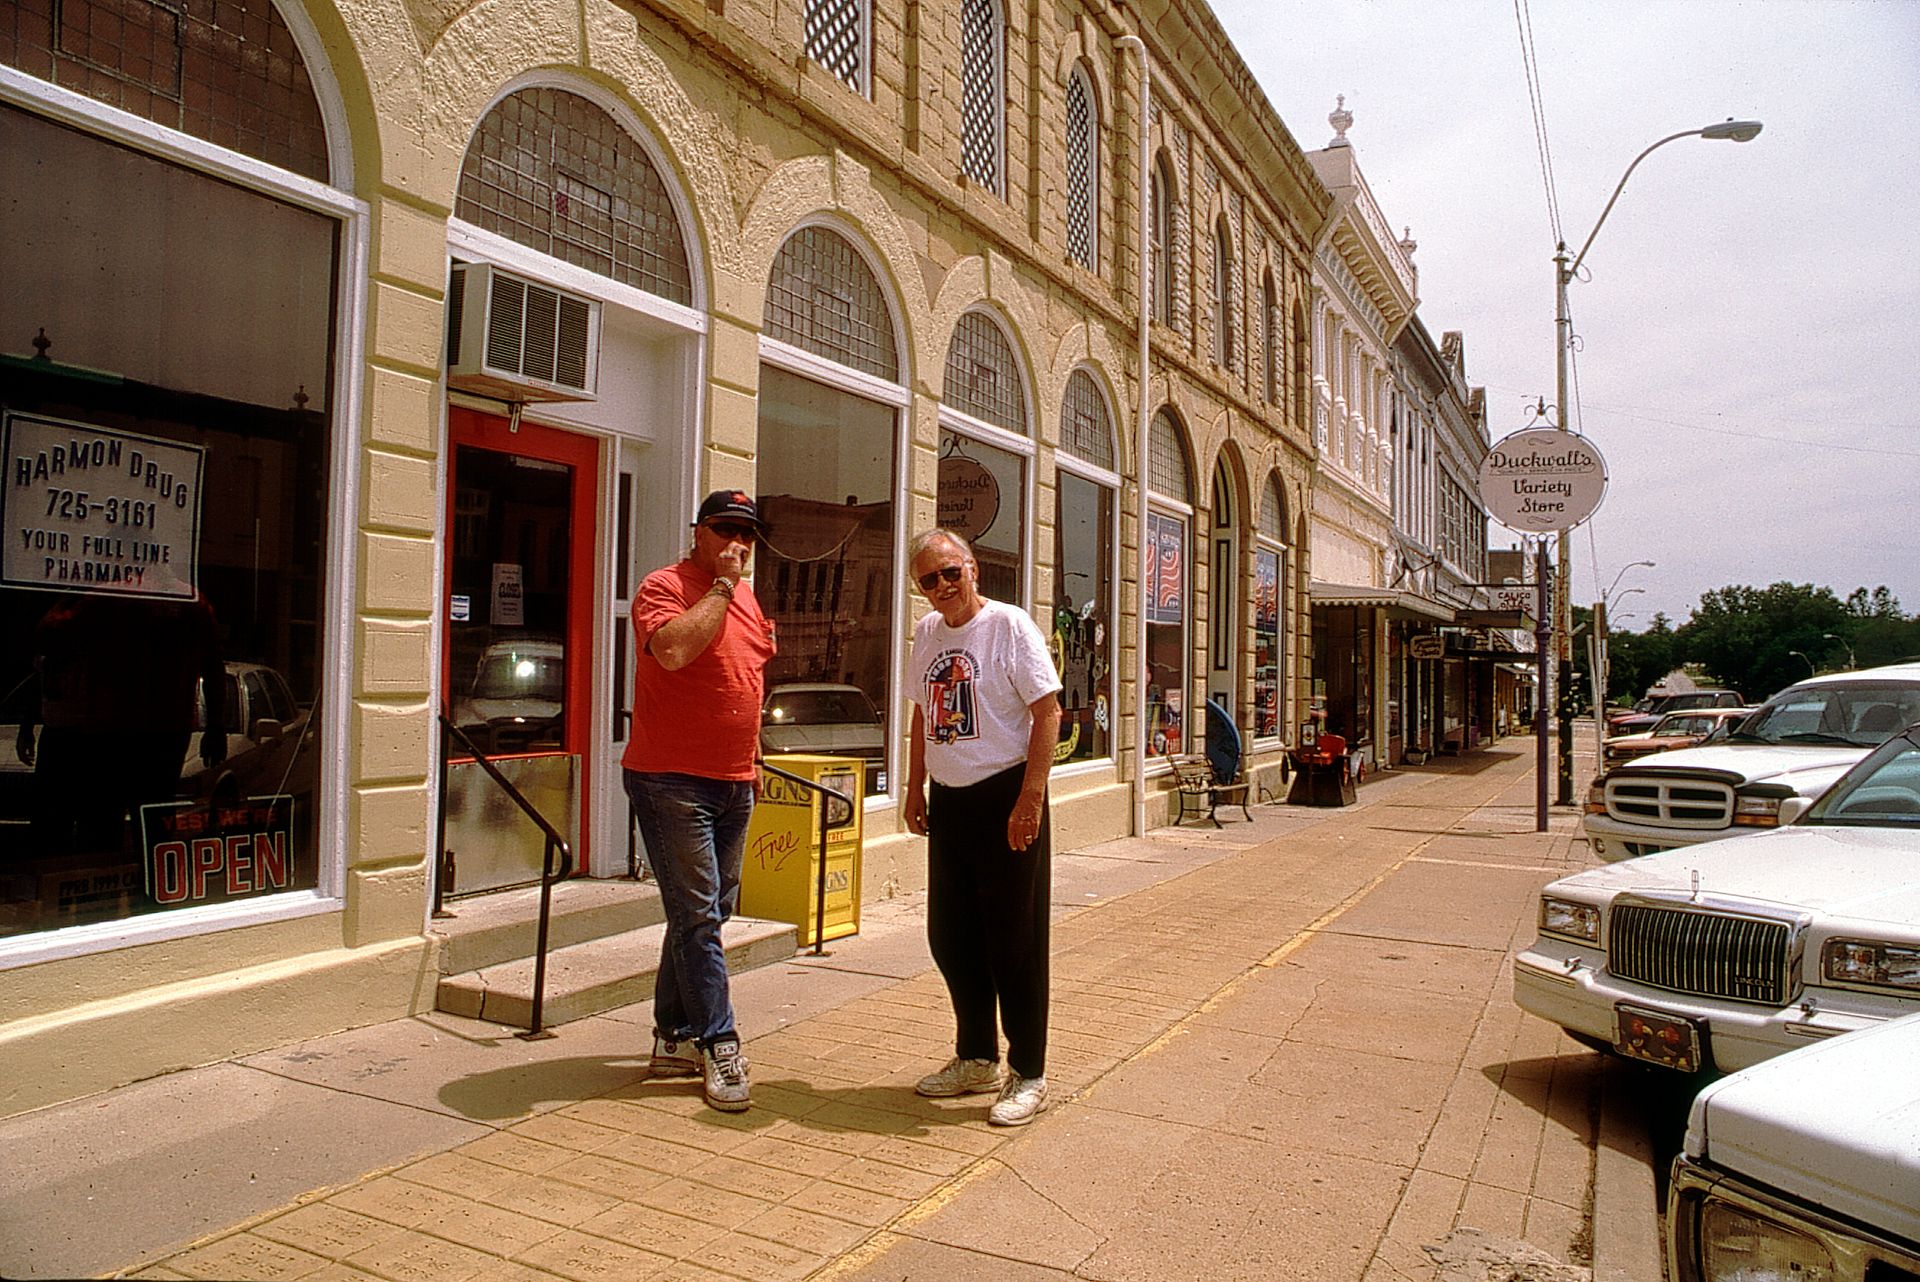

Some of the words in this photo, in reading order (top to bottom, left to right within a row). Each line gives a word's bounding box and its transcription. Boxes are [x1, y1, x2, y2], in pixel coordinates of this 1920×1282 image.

[16, 438, 123, 487] HARMON
[129, 451, 188, 509] DRUG
[1489, 450, 1594, 468] Duckwall's
[1513, 479, 1573, 497] Variety
[46, 487, 156, 530] 725-3161
[1517, 498, 1566, 513] Store
[21, 528, 70, 554] YOUR
[83, 535, 125, 560] FULL
[132, 541, 171, 564] LINE
[44, 556, 146, 586] PHARMACY
[1498, 591, 1531, 599] CALICO
[759, 775, 812, 803] IGNS
[751, 830, 800, 871] Free
[153, 830, 287, 905] OPEN
[1734, 976, 1775, 988] LINCOLN
